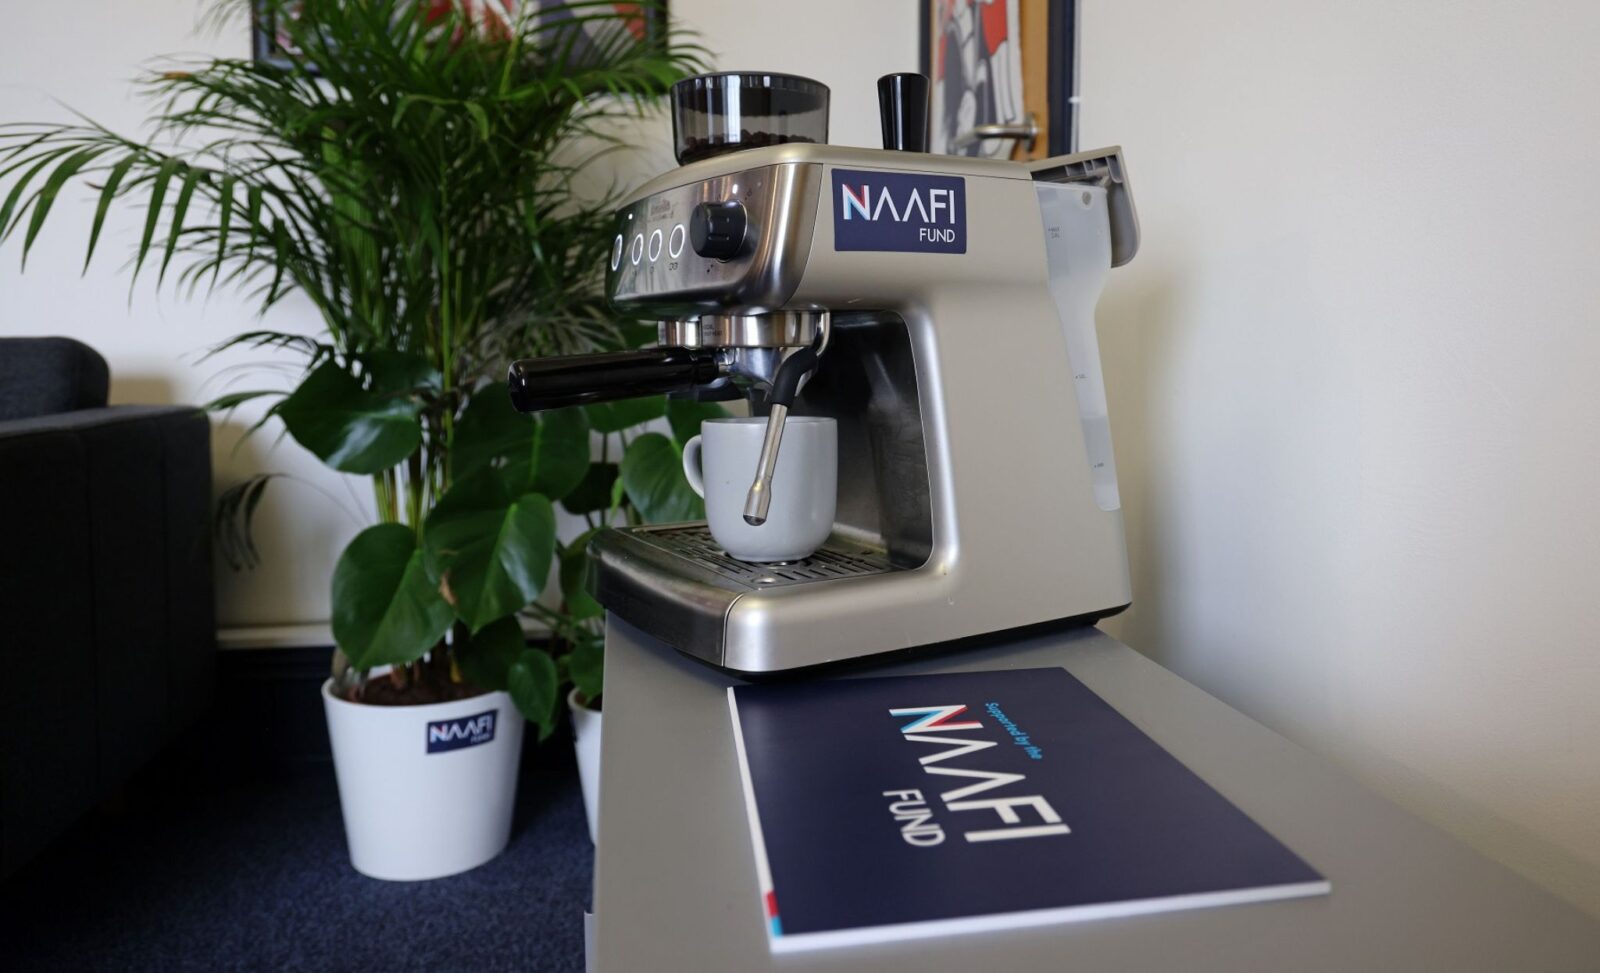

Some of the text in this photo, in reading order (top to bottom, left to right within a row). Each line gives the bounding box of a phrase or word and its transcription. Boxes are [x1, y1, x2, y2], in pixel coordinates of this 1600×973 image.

[842, 184, 955, 224] NAAFI
[920, 228, 955, 242] FUND
[430, 714, 493, 743] NAAFI
[985, 703, 1042, 759] Supported by the
[888, 704, 1071, 842] NAAFI
[882, 789, 946, 846] FUND
